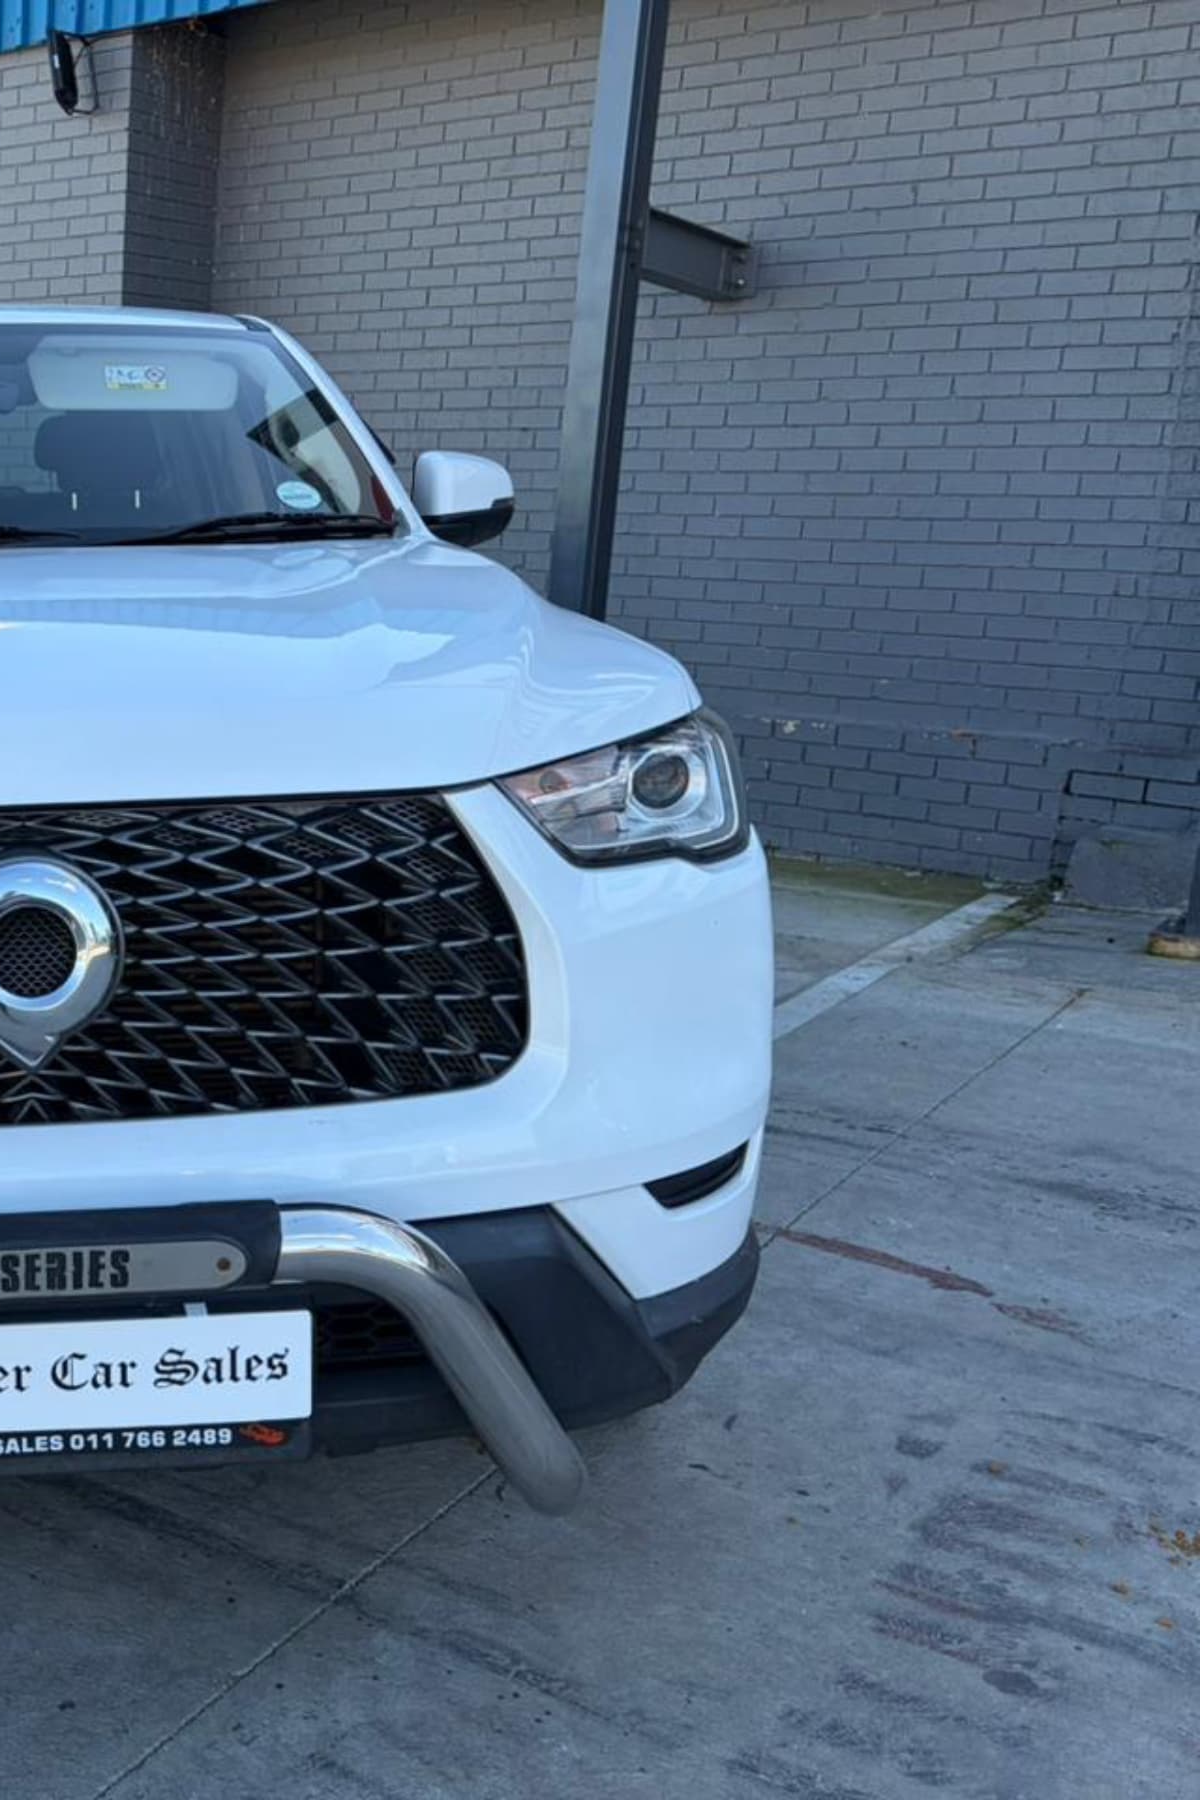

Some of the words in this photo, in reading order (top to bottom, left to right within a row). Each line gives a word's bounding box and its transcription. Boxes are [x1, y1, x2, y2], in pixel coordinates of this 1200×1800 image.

[50, 1352, 137, 1390] Car
[153, 1345, 290, 1388] Sales
[69, 1432, 114, 1450] 011
[121, 1430, 165, 1448] 766
[173, 1428, 233, 1446] 2489
